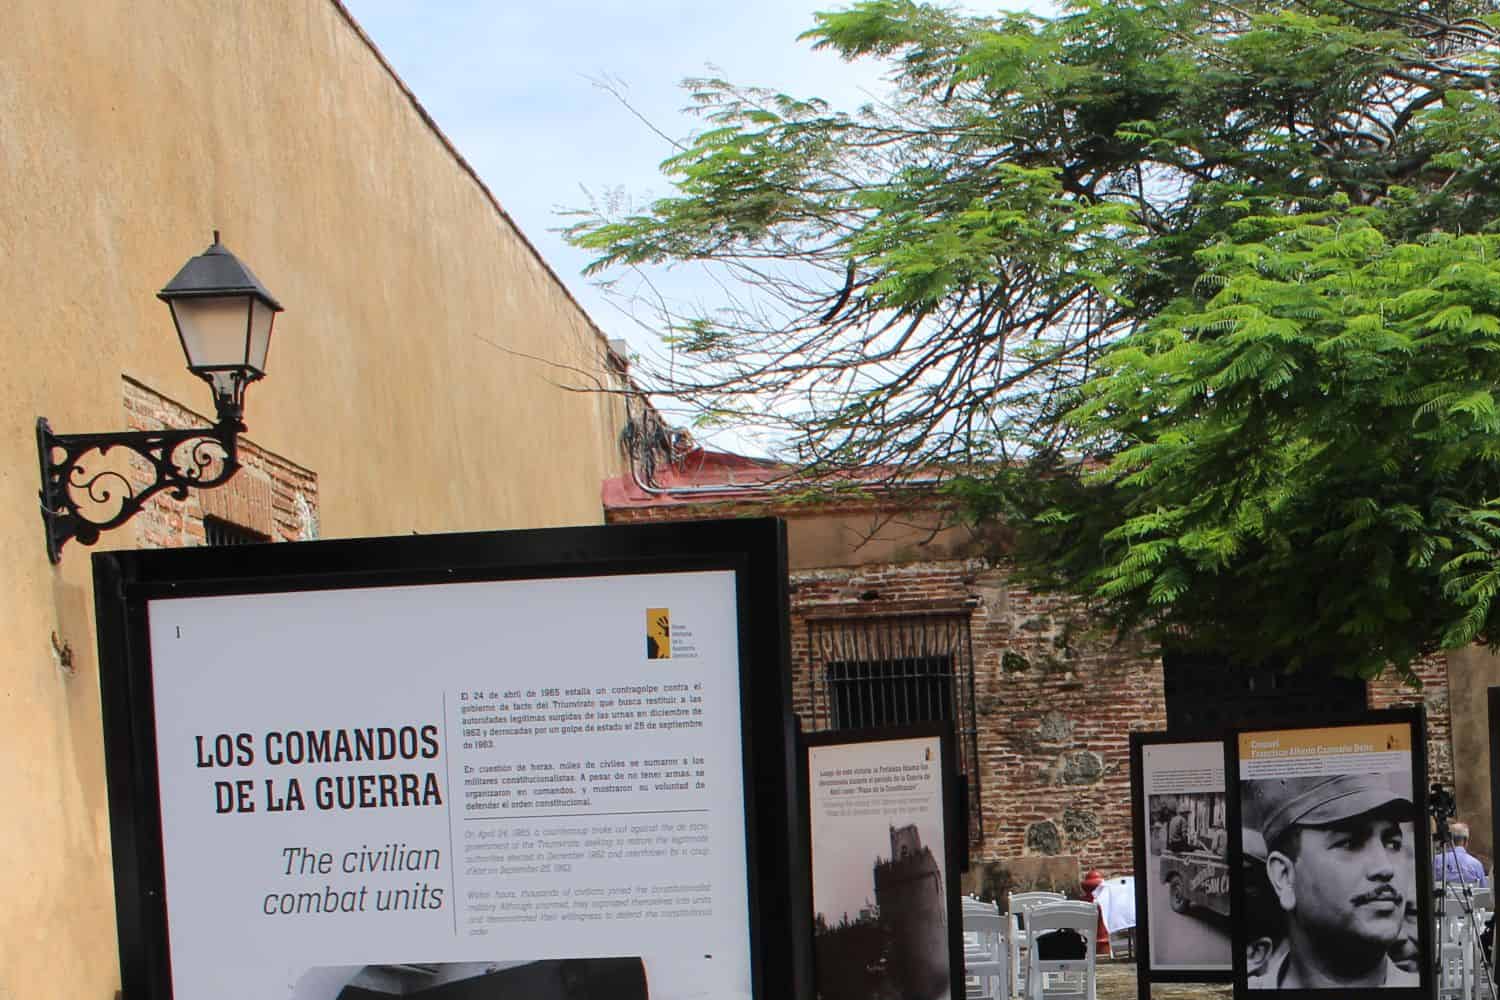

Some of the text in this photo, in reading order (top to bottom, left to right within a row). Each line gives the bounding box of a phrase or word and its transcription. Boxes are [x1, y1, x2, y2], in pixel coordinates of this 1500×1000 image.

[195, 725, 439, 768] LOS COMANDOS
[215, 773, 442, 814] DE LA GUERRA
[282, 847, 332, 874] The
[342, 843, 440, 874] civilian
[263, 885, 367, 914] combat
[376, 882, 443, 910] units
